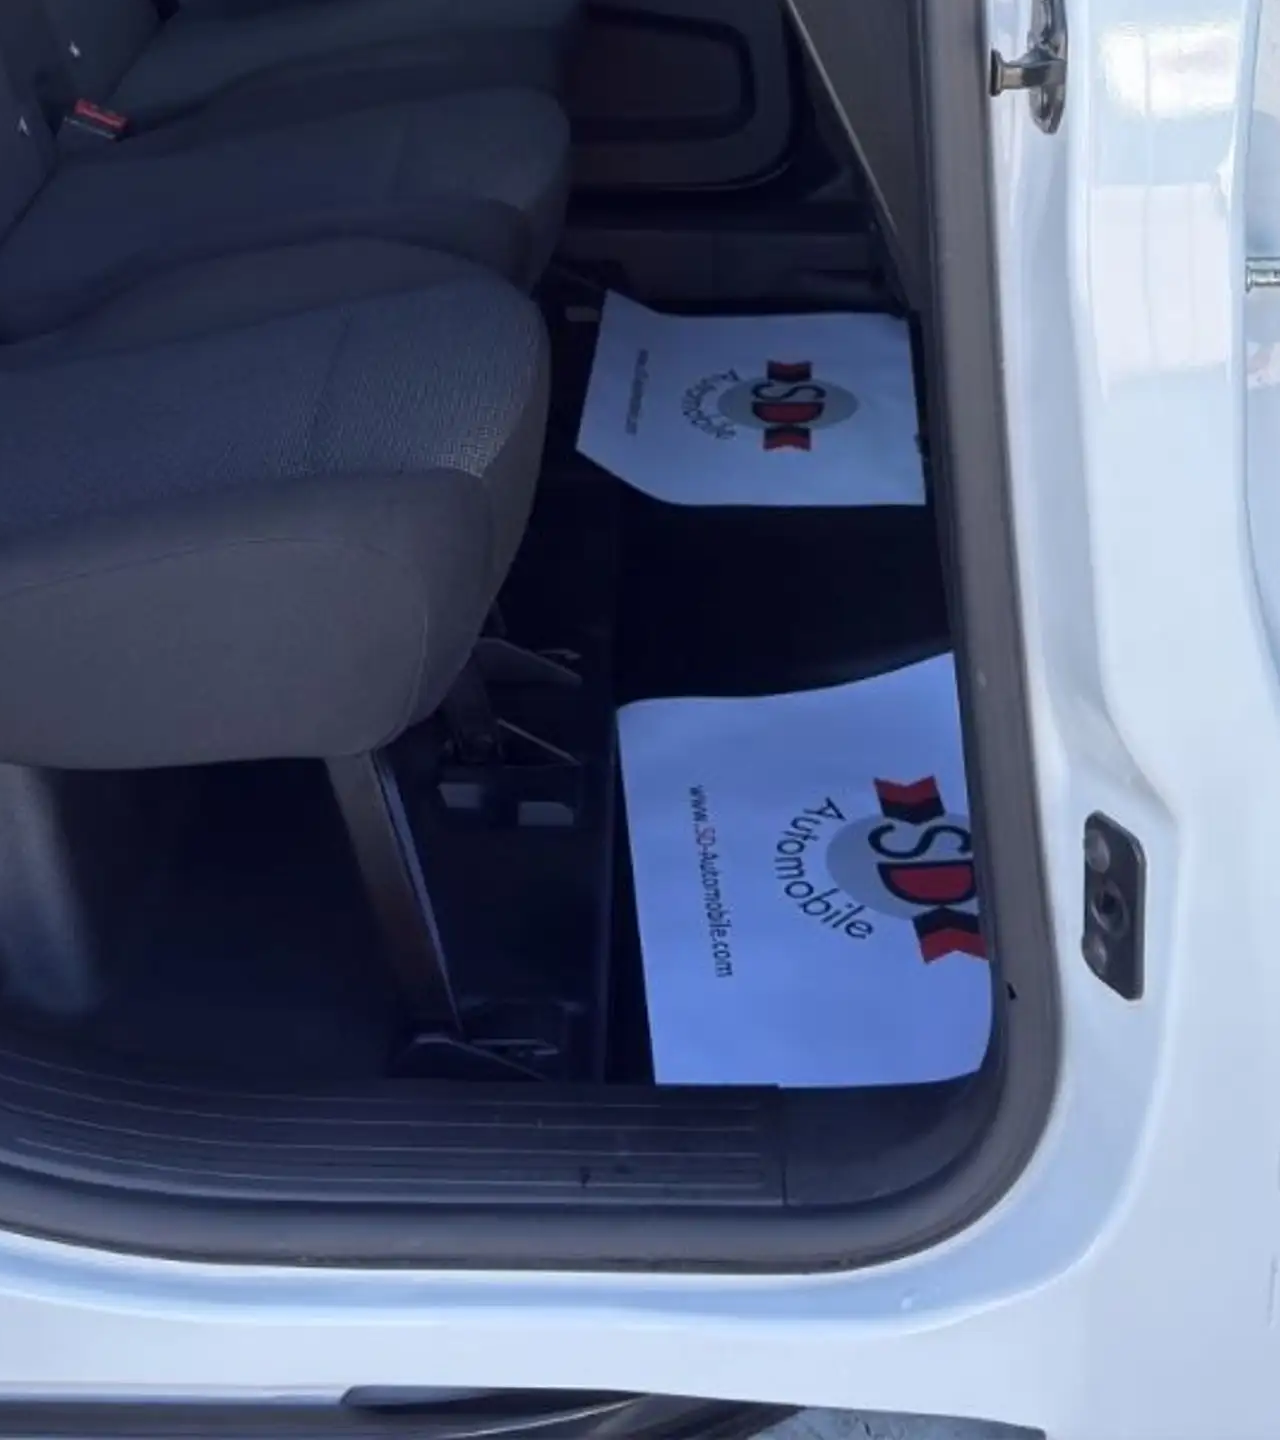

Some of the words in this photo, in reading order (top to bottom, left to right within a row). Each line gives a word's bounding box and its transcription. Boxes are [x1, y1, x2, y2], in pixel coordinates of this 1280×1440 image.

[751, 380, 827, 423] SD
[688, 785, 733, 978] www.SD-Automobile.com
[774, 797, 874, 940] Automobile
[868, 823, 977, 906] SD
